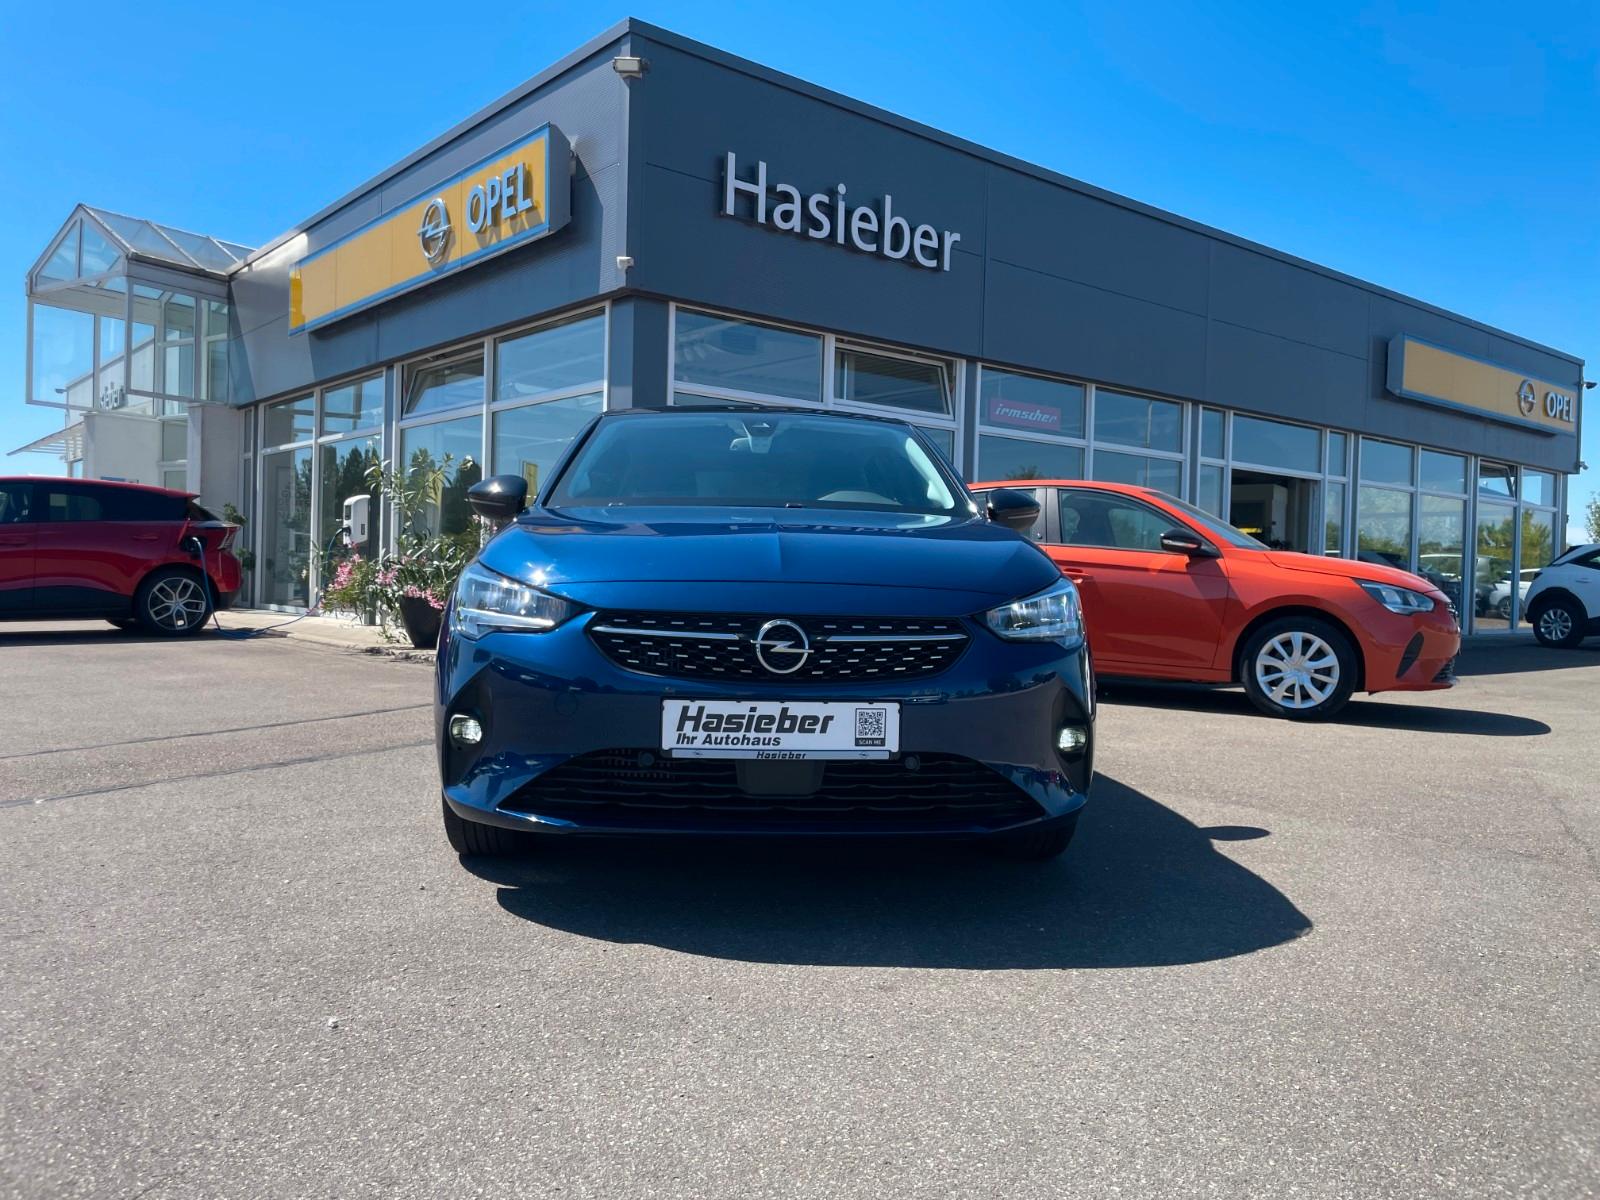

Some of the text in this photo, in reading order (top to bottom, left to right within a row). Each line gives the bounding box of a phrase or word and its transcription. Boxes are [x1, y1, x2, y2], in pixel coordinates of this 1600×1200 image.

[465, 161, 533, 234] OPEL
[725, 151, 961, 272] Hasieber
[995, 403, 1057, 424] irmscher
[1546, 390, 1575, 423] OPEL
[676, 705, 835, 734] Hasieber
[676, 733, 781, 747] Ihr Autohaus
[756, 751, 807, 760] Hasieber
